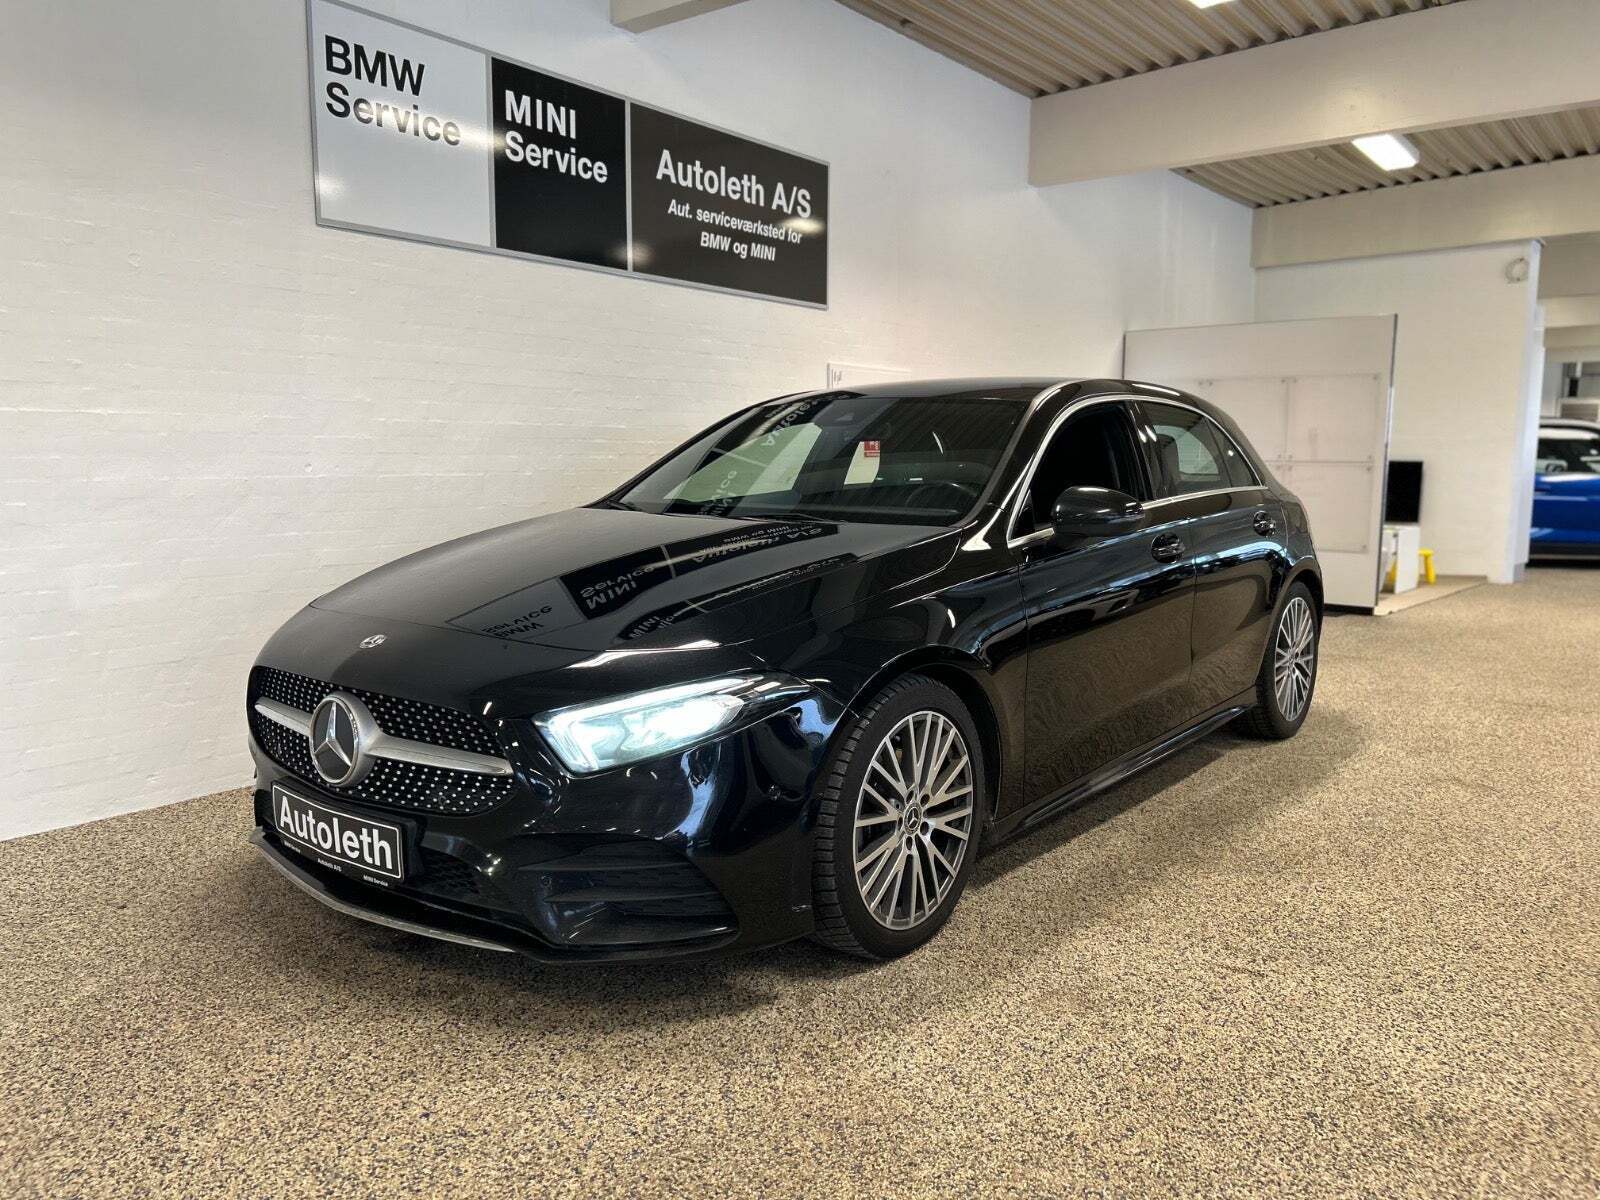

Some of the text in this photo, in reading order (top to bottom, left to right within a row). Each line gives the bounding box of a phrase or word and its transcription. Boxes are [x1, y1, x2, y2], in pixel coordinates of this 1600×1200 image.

[324, 34, 425, 97] BMW
[325, 81, 462, 146] Service
[505, 89, 576, 140] MINI
[505, 130, 608, 184] Service
[656, 148, 812, 219] Autoleth A/S
[667, 199, 803, 245] Aut. serviceværksted for
[701, 231, 776, 262] BMW og MINI
[279, 795, 393, 870] Autoleth
